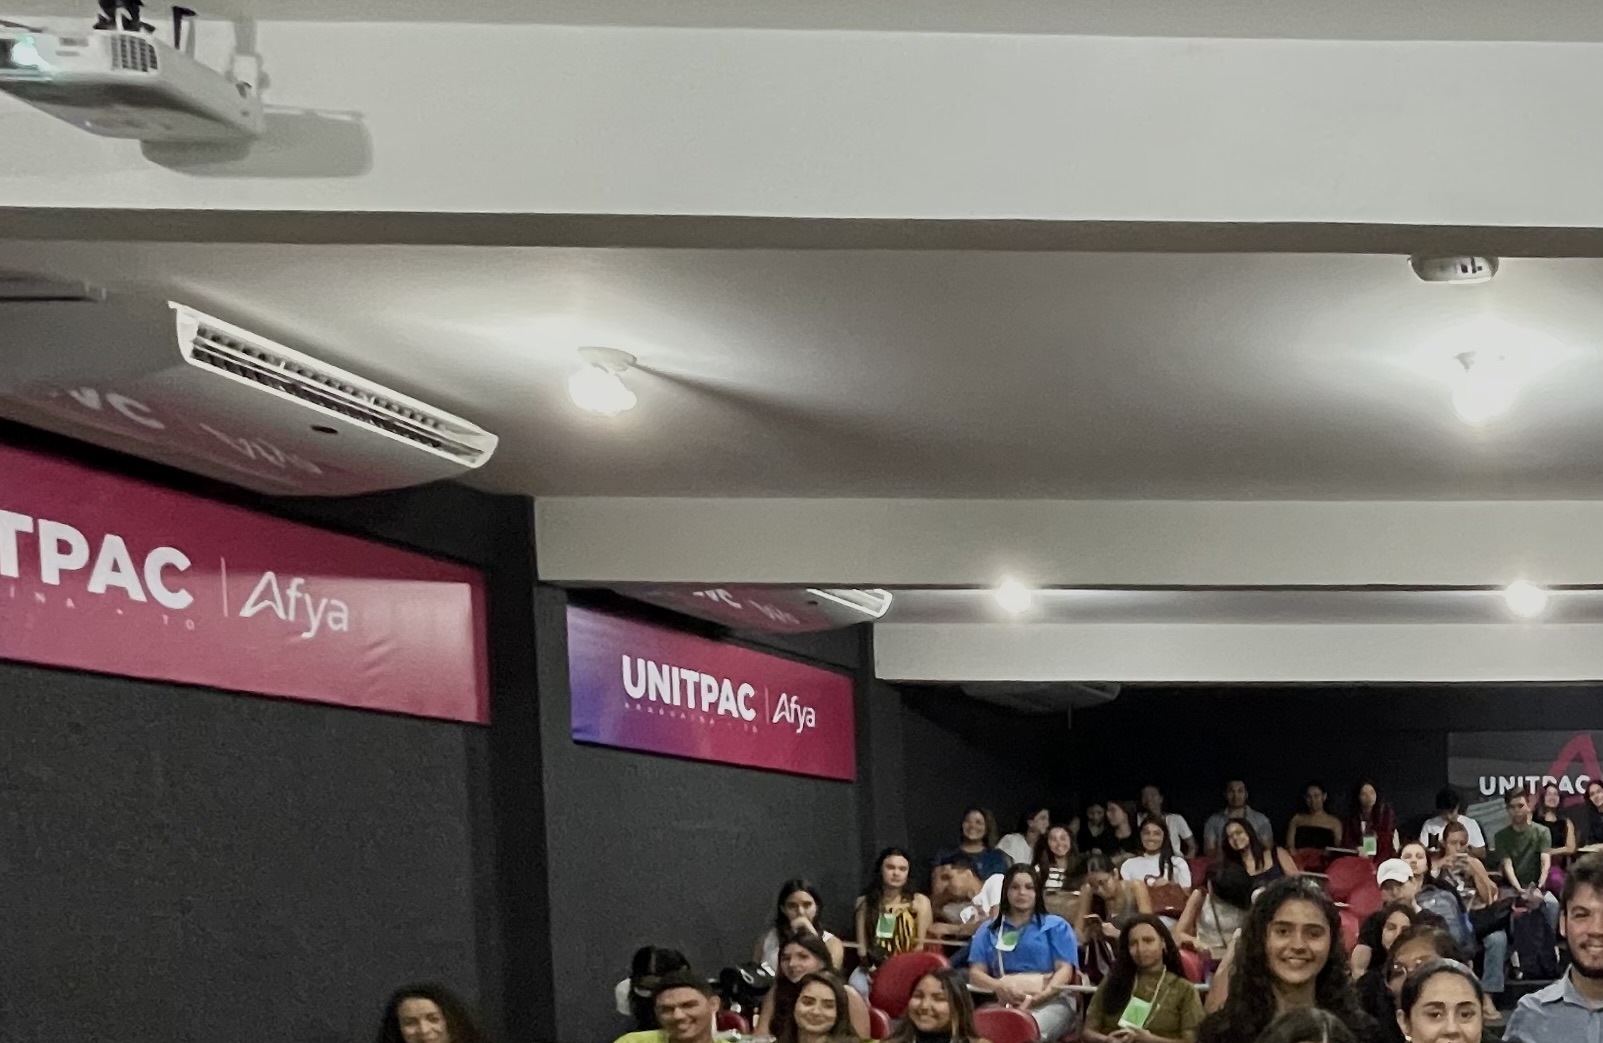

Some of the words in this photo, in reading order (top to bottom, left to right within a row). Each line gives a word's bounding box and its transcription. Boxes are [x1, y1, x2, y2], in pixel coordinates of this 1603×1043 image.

[238, 570, 351, 640] Afya
[621, 654, 757, 722] UNITPAC
[771, 692, 816, 733] Afya
